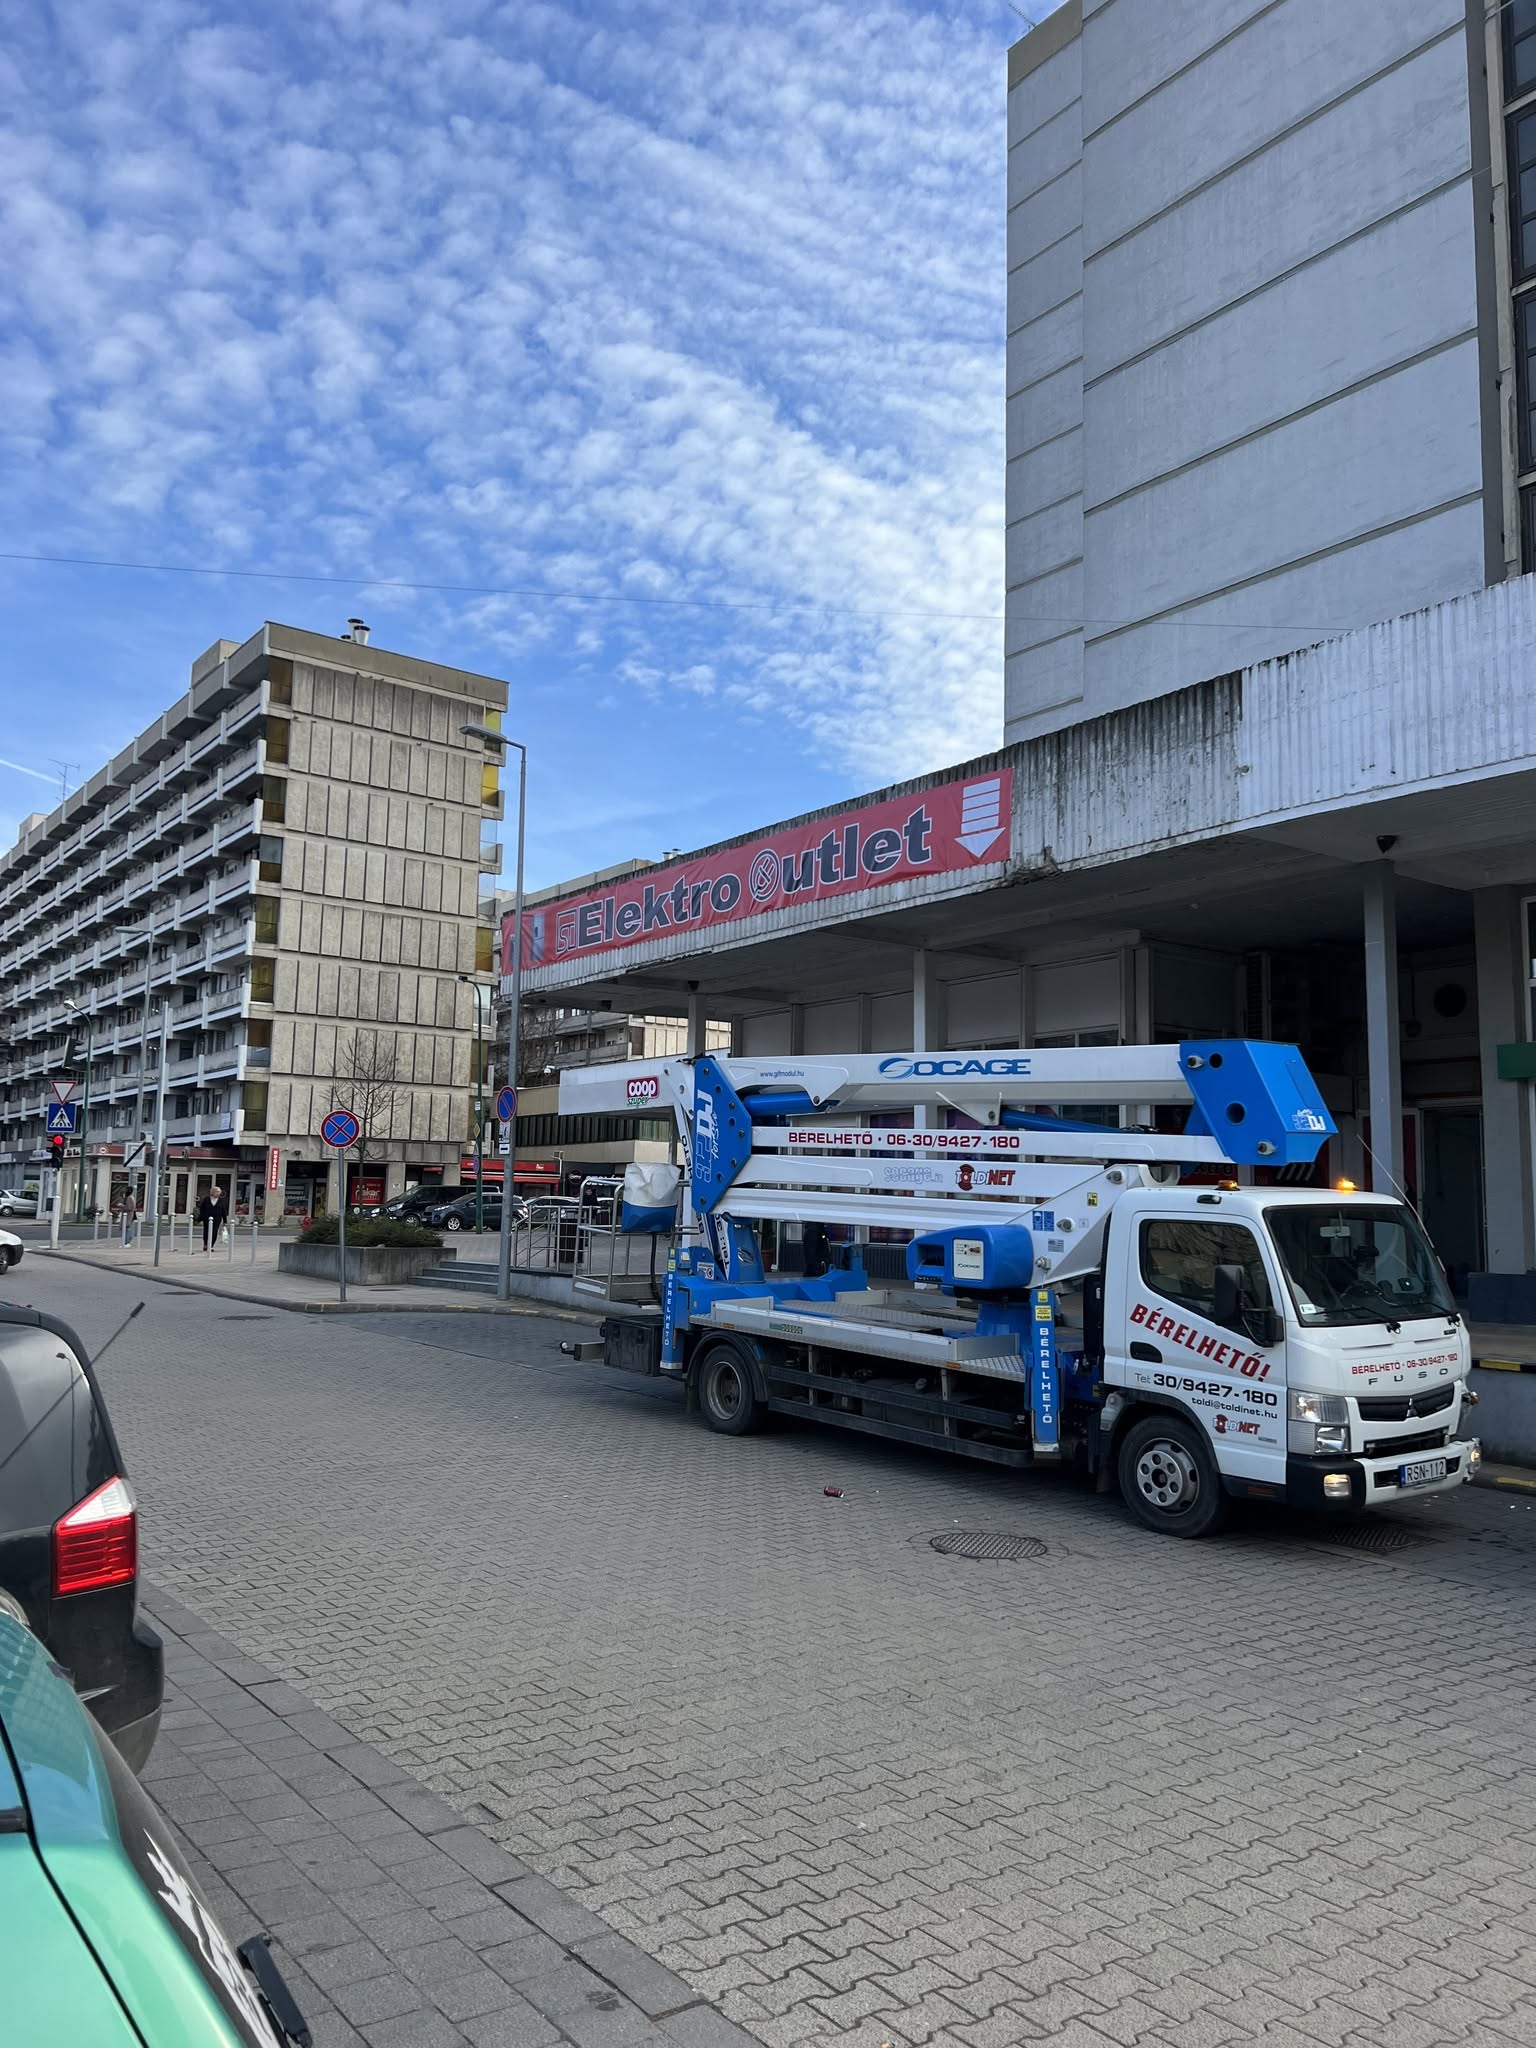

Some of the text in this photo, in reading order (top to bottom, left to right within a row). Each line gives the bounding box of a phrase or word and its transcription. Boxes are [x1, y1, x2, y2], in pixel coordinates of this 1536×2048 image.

[577, 873, 741, 949] Elektro
[749, 804, 933, 902] Outlet
[629, 1080, 656, 1098] coop
[788, 1130, 1021, 1149] BÉRELHETŐ 06-30/9427-180
[1130, 1303, 1271, 1382] BÉRELHETŐ!
[1368, 1368, 1449, 1386] FUSO
[1153, 1373, 1278, 1406] 30/9427-180
[1191, 1397, 1278, 1419] toldi@toldinet.hu
[1406, 1461, 1445, 1481] RSN-112
